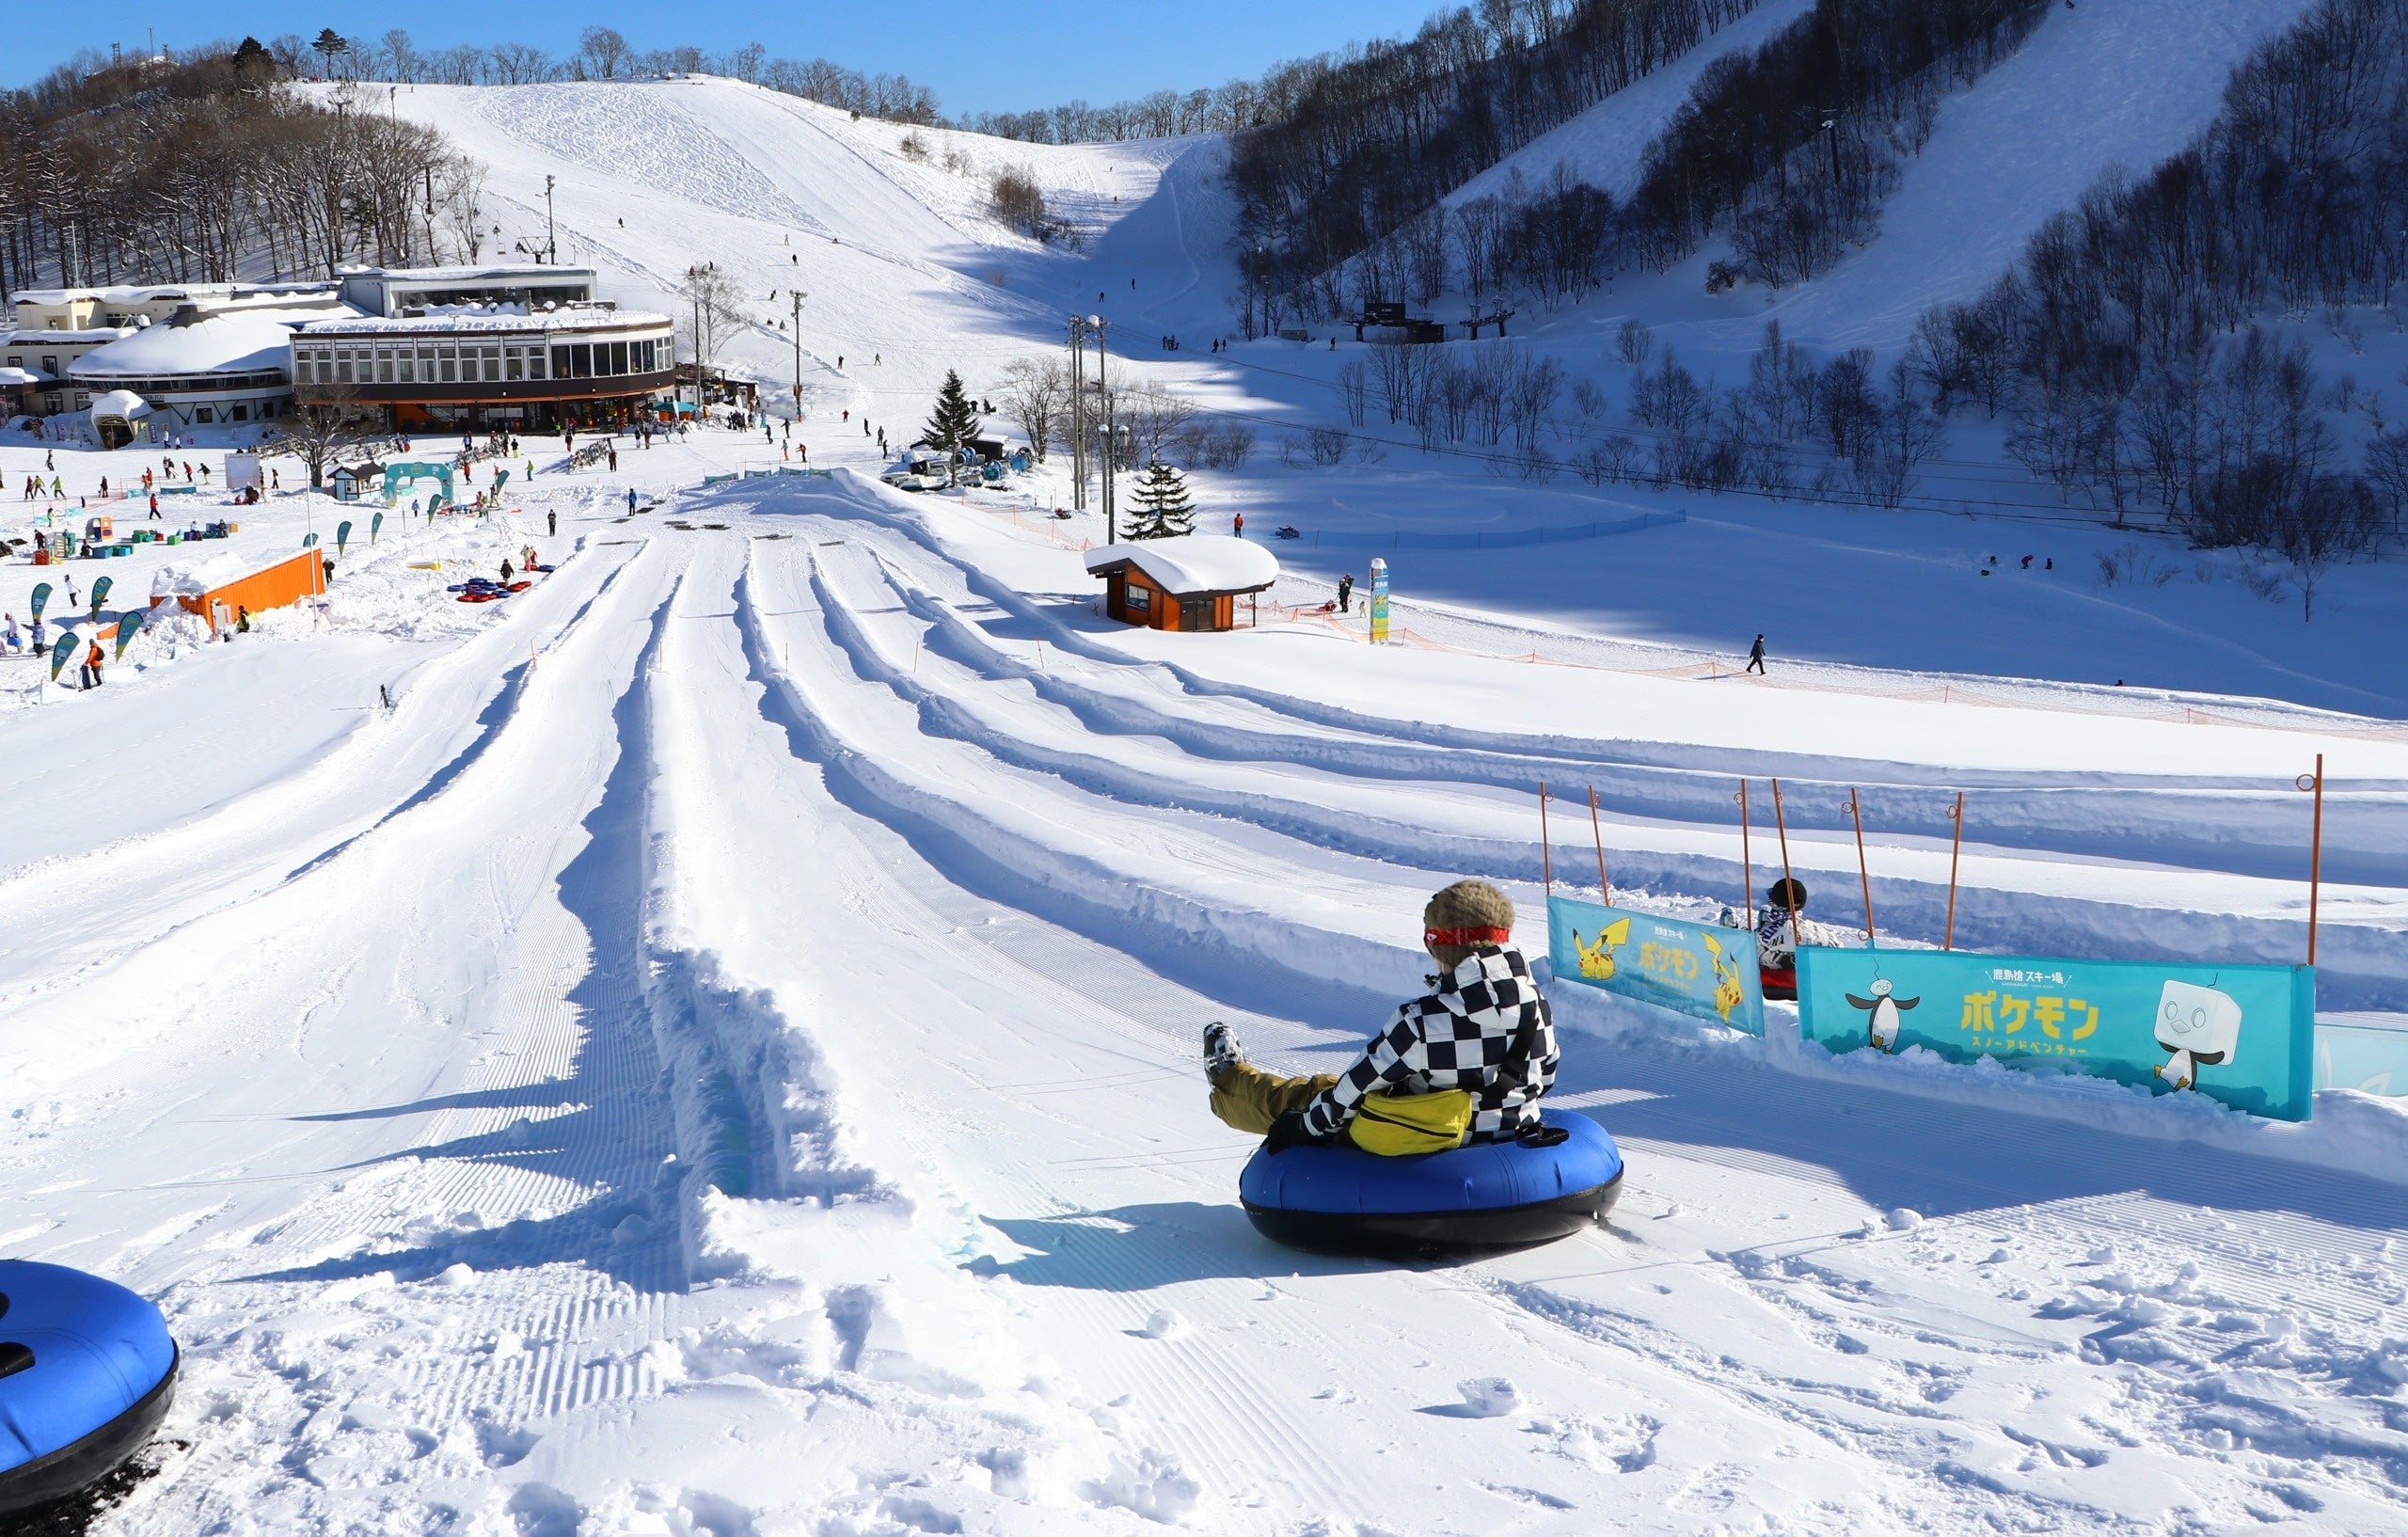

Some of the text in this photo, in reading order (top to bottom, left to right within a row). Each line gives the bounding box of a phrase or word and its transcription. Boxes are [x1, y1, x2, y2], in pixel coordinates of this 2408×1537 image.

[1640, 942, 1699, 980] ポケモン
[1993, 969, 2064, 985] 鹿島槍 スキー場
[1960, 990, 2099, 1041] ポケモン
[1972, 1036, 2087, 1055] スノーアドベンチャー
